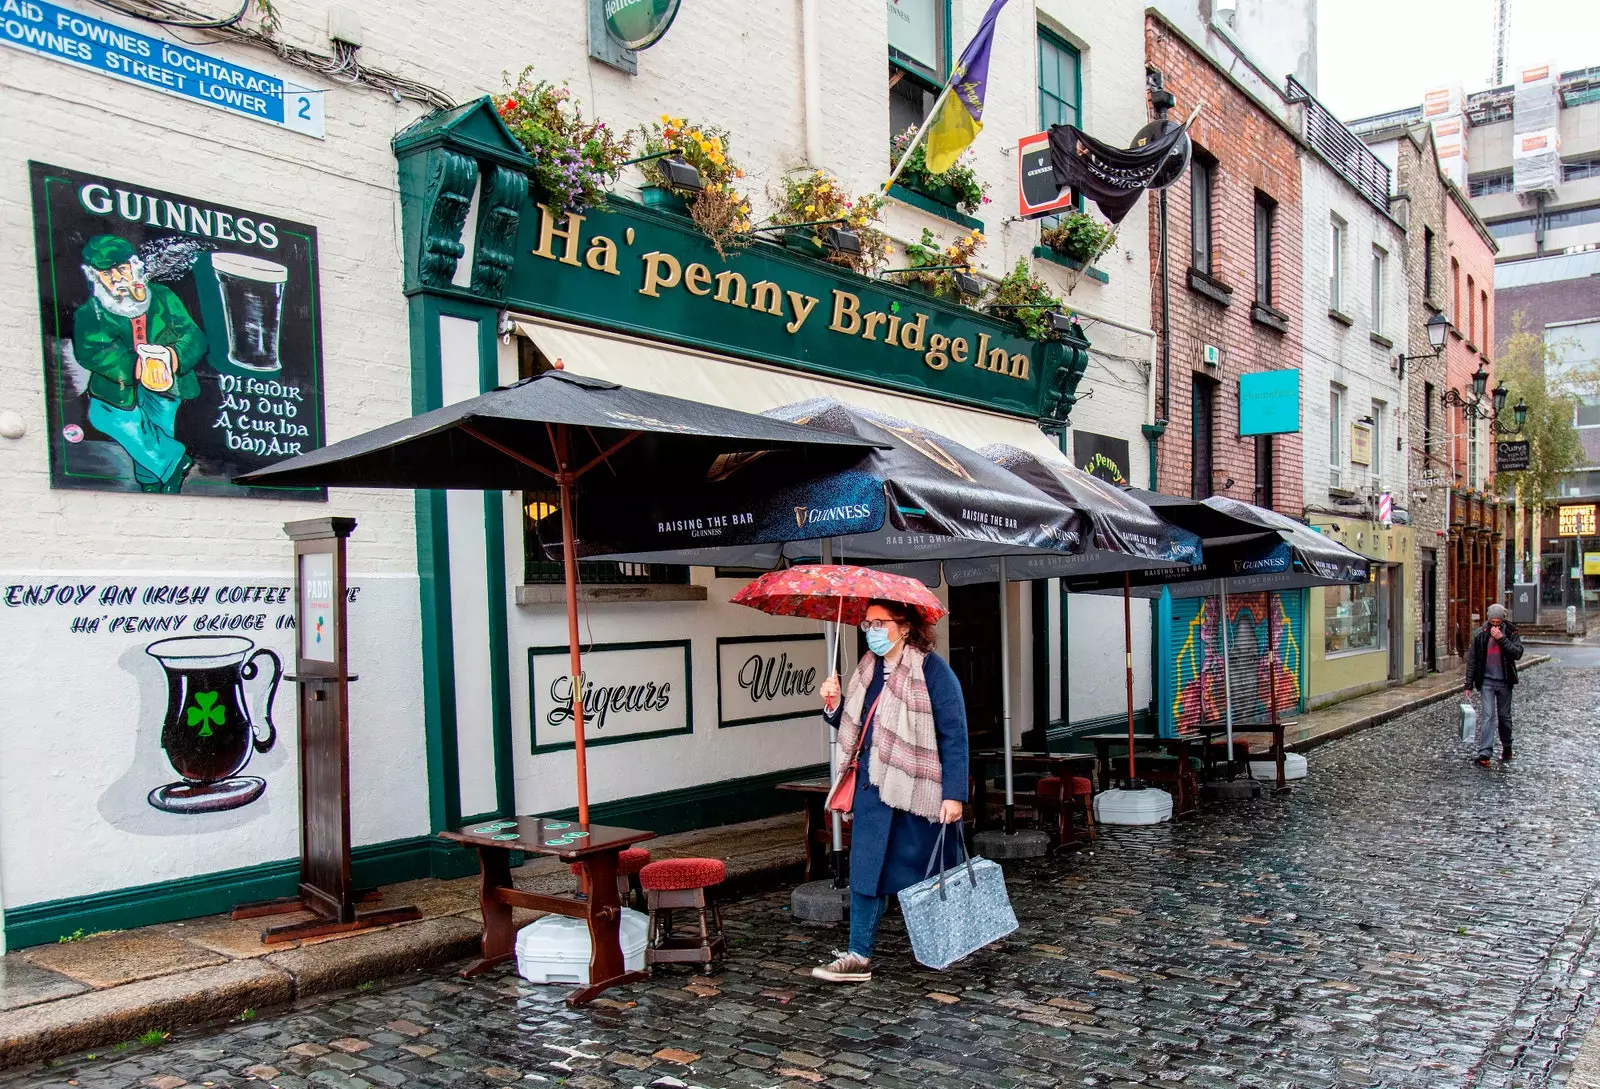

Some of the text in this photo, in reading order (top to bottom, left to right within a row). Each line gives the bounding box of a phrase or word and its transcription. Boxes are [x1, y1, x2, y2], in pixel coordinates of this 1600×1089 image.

[57, 13, 151, 57] FOWNES
[162, 44, 283, 100] ÍOCHTARACH
[105, 51, 187, 90] STREET
[199, 80, 267, 114] LOWER
[297, 97, 311, 121] 2
[80, 183, 280, 249] GUINNESS
[829, 288, 969, 372] Bridge
[974, 332, 1031, 381] Inn
[212, 411, 233, 429] A
[658, 513, 754, 533] RAISING THE BAR
[808, 504, 871, 524] GUINNESS
[962, 508, 1018, 529] RAISING THE BAR
[1560, 515, 1595, 525] BURER
[691, 528, 722, 538] GUINNESS
[1560, 524, 1595, 532] KITCEN
[1144, 567, 1174, 577] RAISING
[1243, 558, 1285, 570] GUINNESS
[3, 584, 291, 607] ENJOY AN IRISH COFFEE
[307, 580, 333, 599] PADDY
[70, 615, 188, 634] HA'PENNY
[737, 652, 818, 703] Wine
